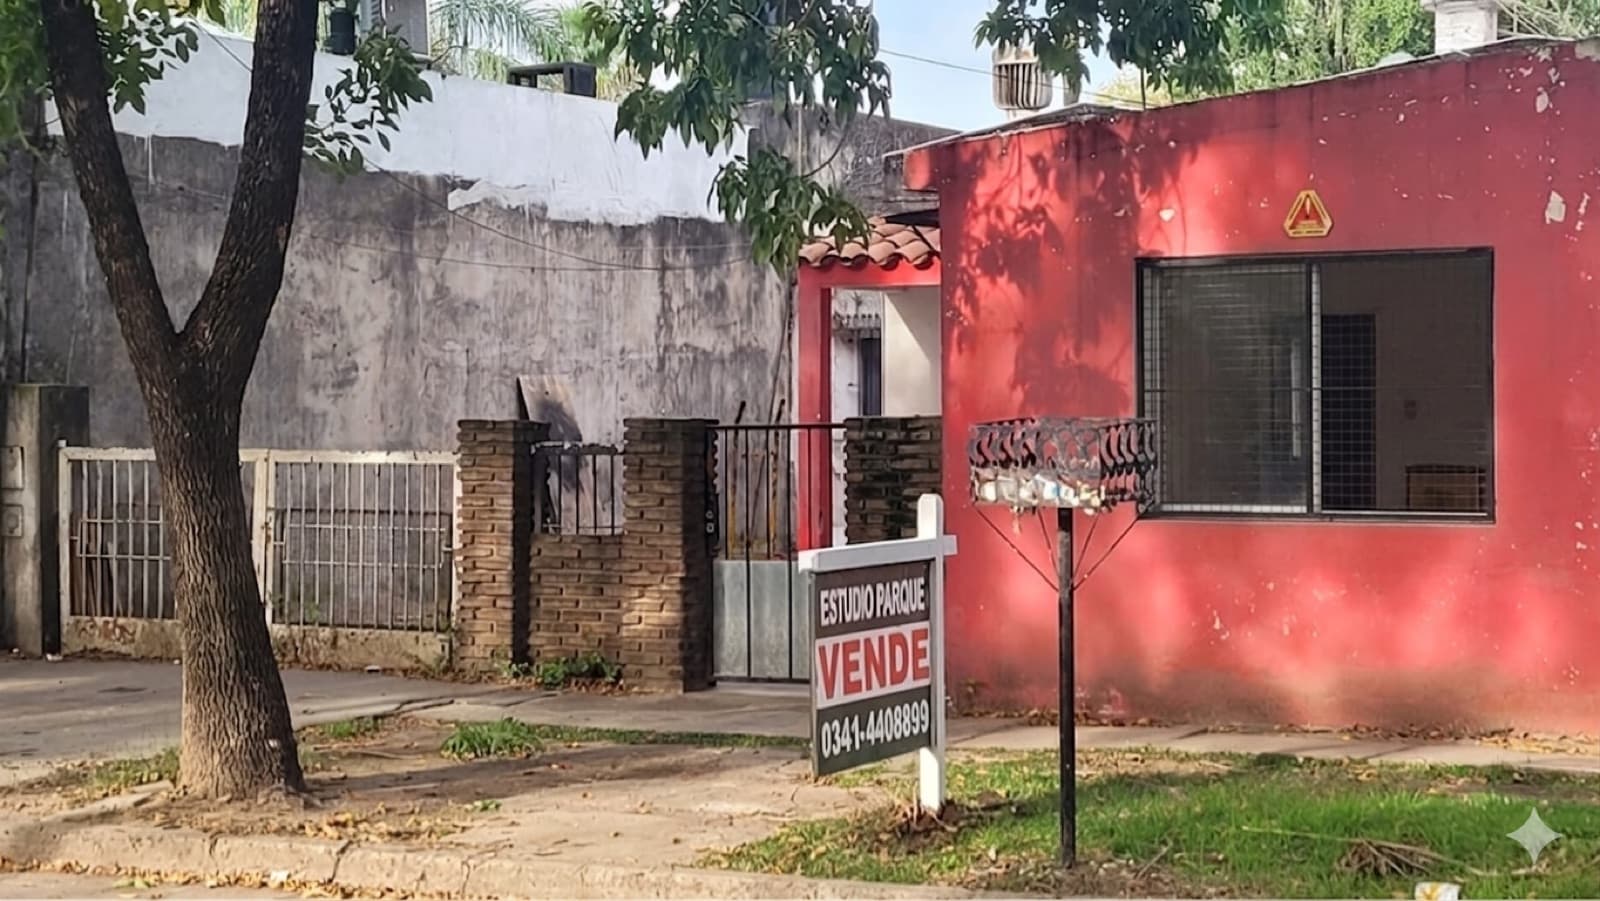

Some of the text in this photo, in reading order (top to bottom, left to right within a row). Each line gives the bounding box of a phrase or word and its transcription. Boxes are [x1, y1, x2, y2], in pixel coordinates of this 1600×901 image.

[820, 577, 925, 626] ESTUDIO PARQUE
[818, 628, 930, 699] VENDE
[821, 699, 929, 758] 0341-4408899
